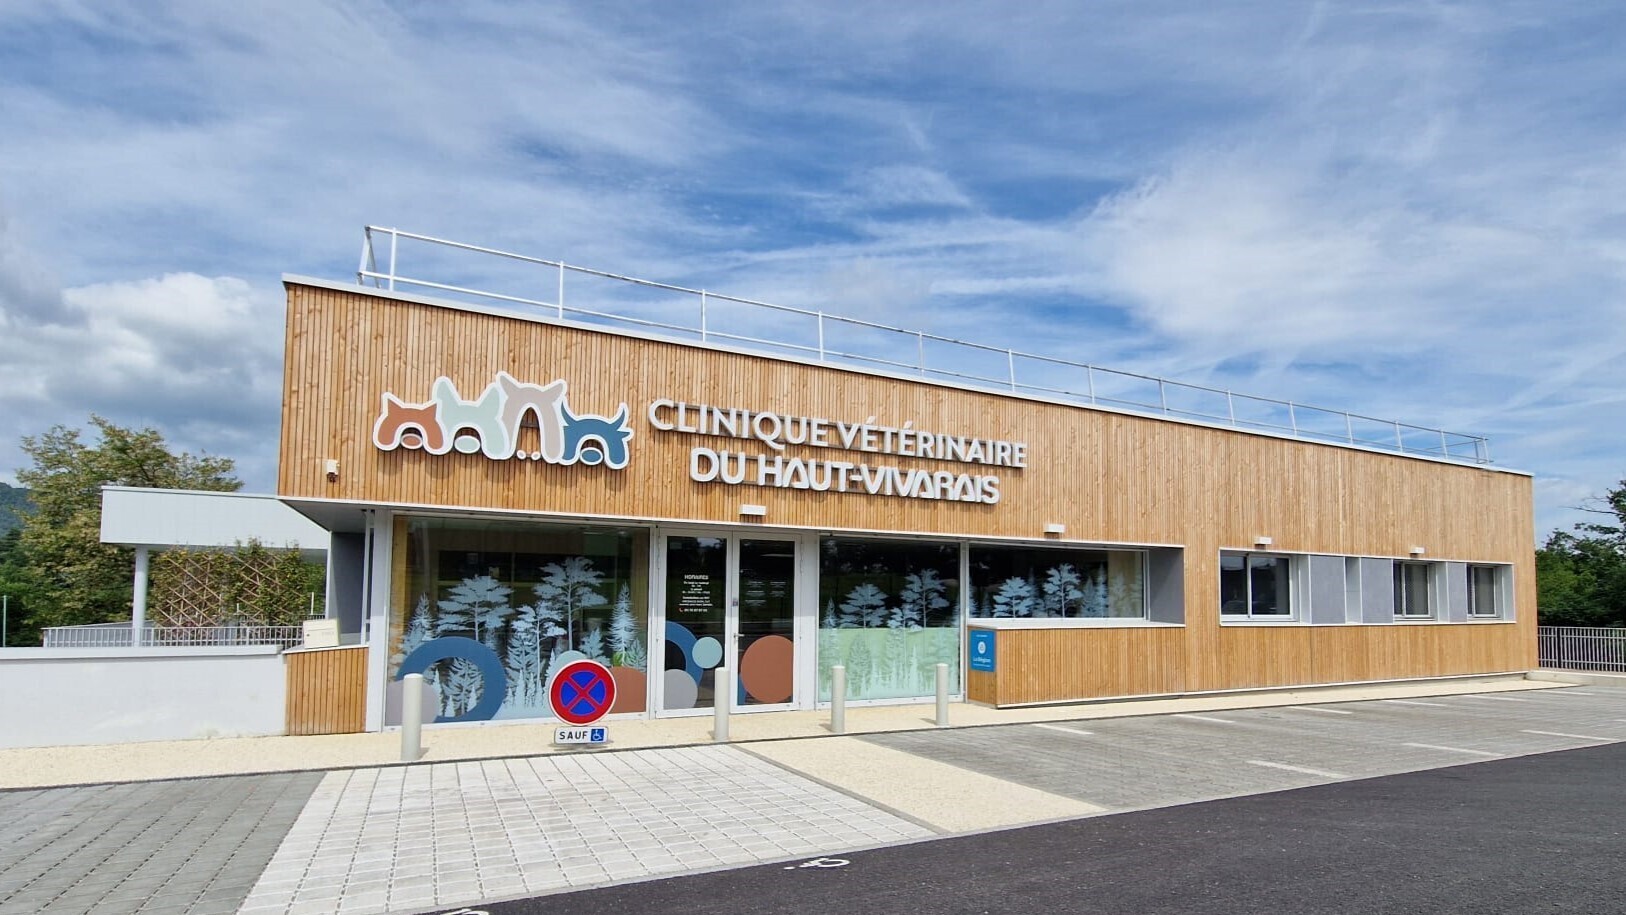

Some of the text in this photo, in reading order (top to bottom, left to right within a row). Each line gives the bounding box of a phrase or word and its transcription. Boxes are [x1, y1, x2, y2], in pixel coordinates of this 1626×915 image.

[648, 399, 1028, 468] CLINIQUE VÉTÉRINAIRE
[690, 447, 1000, 505] DU HAUT-VIVARAIS
[559, 730, 588, 740] SAUF
